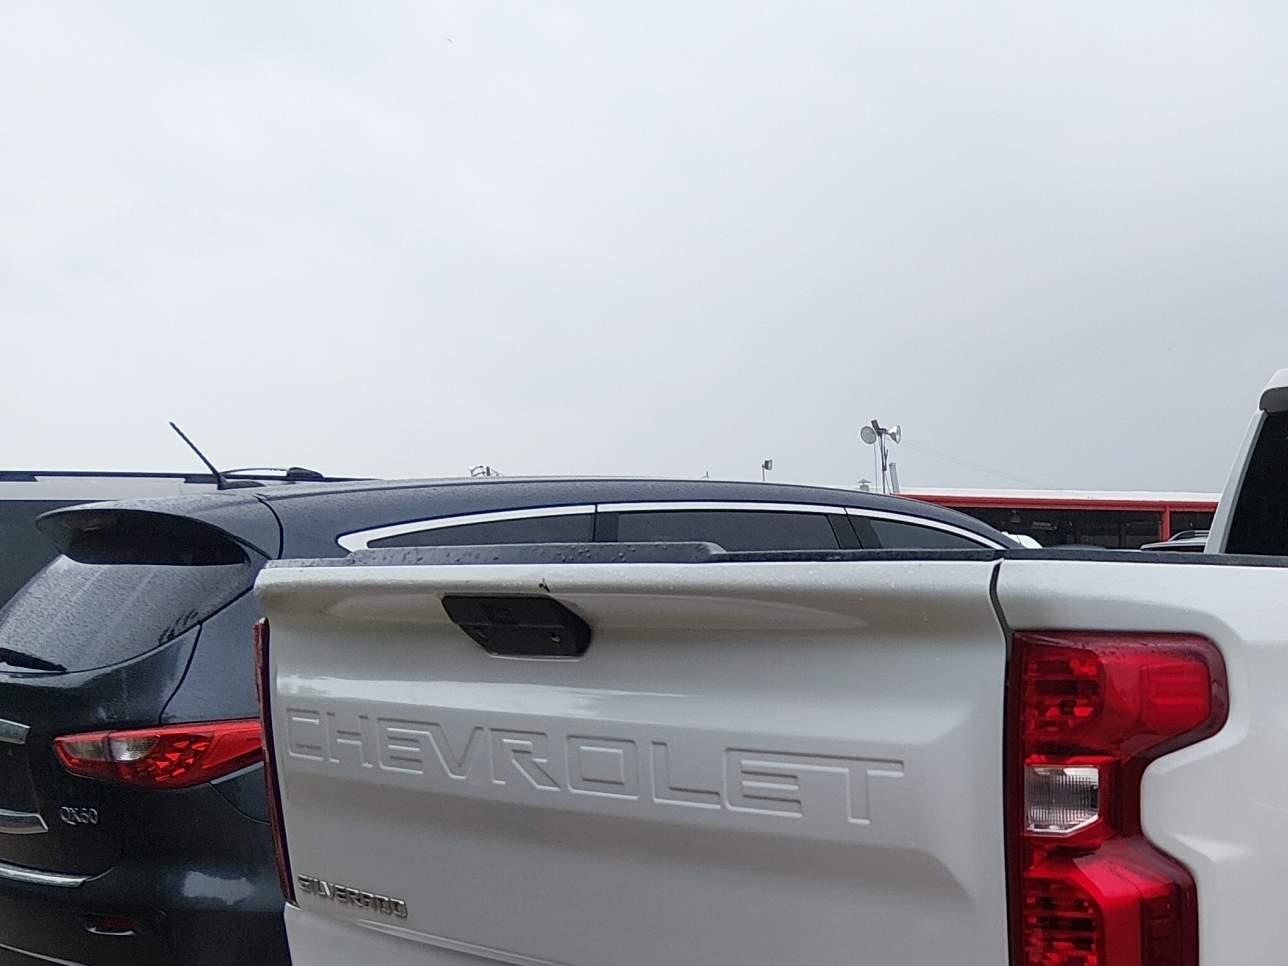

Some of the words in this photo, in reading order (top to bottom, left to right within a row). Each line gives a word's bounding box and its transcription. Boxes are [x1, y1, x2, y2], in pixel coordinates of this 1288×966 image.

[286, 707, 905, 825] CHEVROLET
[60, 806, 98, 825] QX60
[297, 874, 408, 919] SILVERADO
